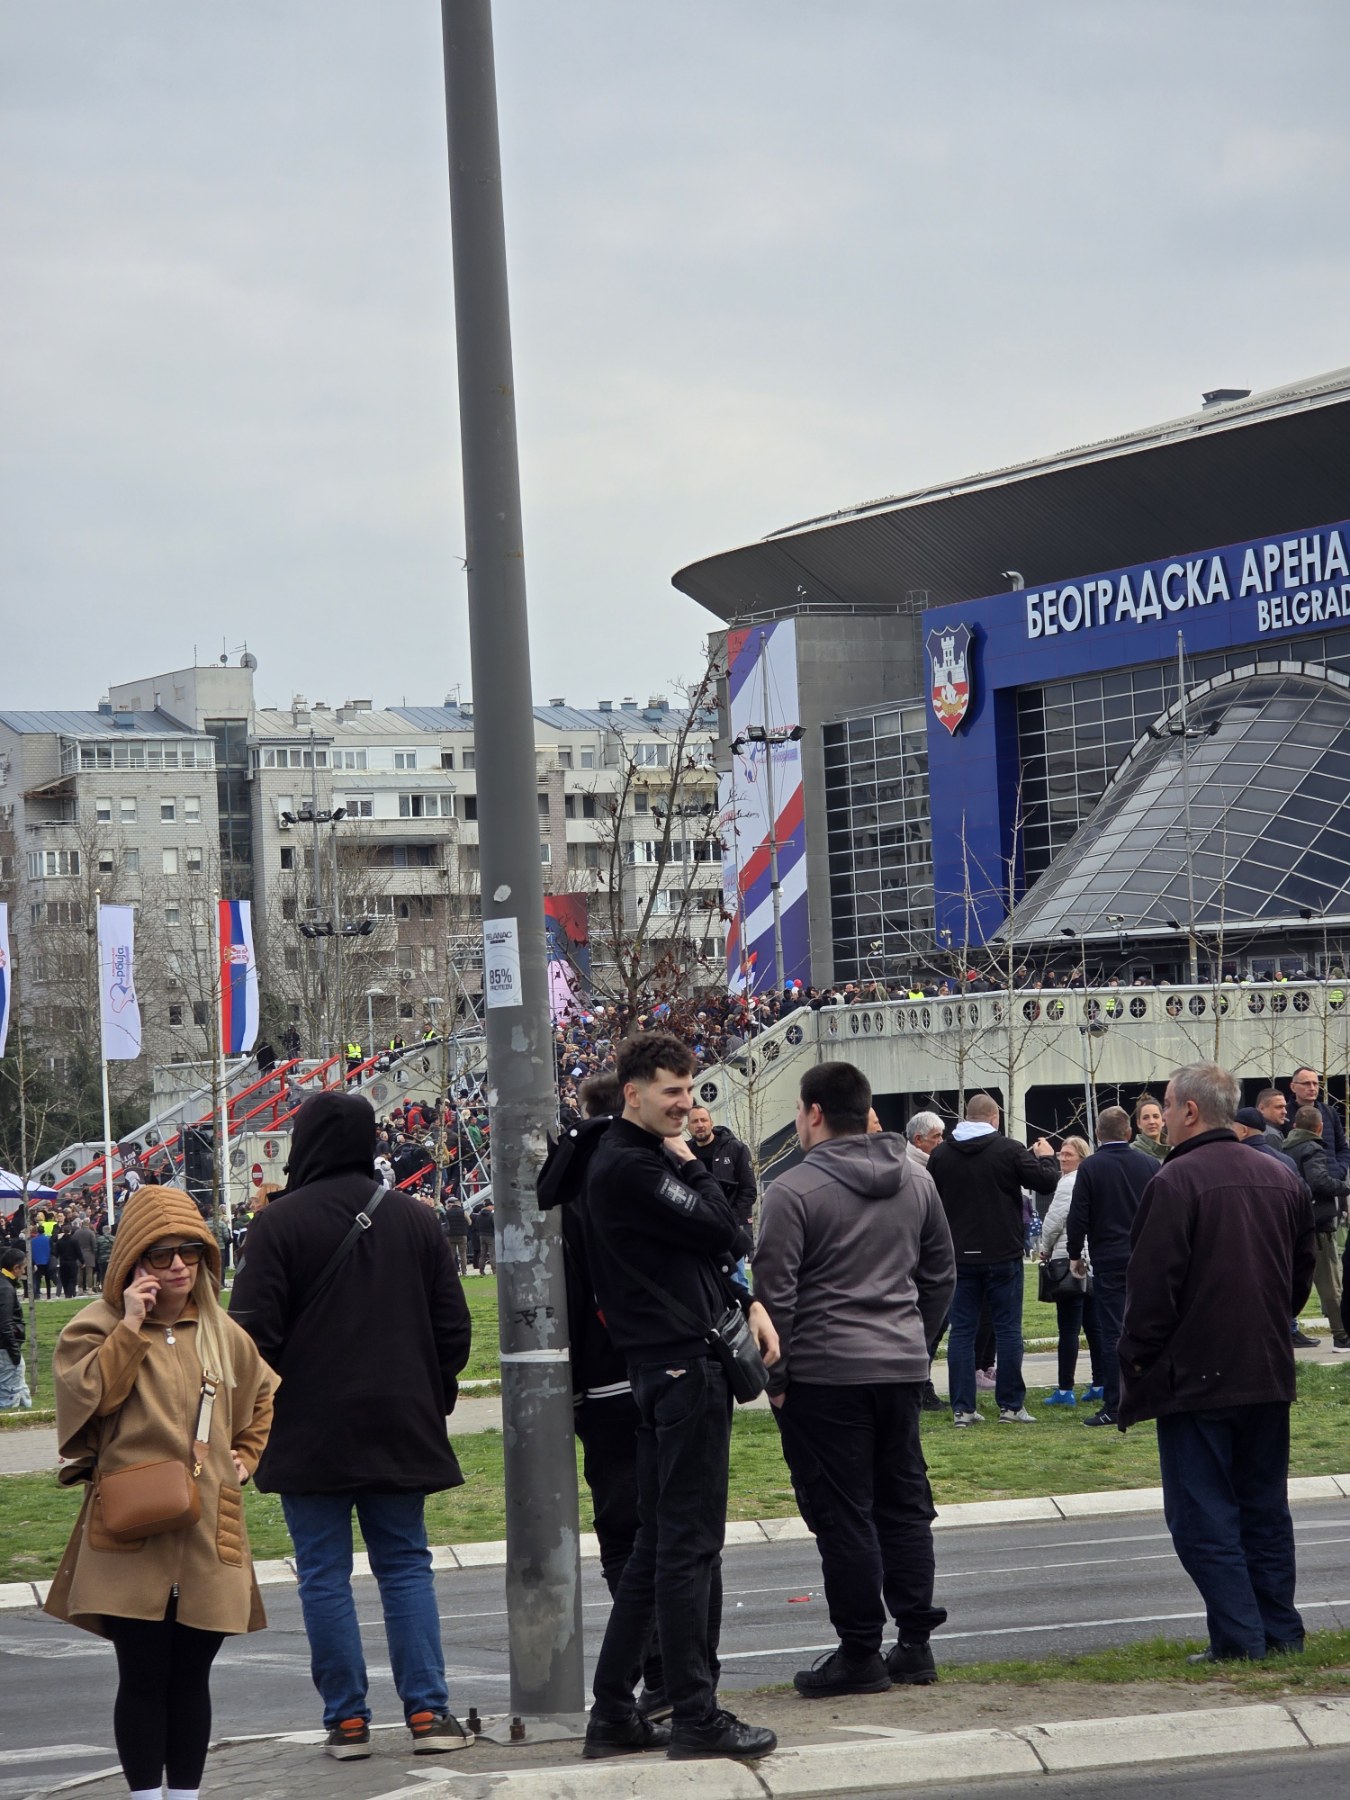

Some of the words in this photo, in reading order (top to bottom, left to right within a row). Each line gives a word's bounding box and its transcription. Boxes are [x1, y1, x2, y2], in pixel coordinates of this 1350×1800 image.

[1026, 555, 1231, 639] БЕОГРАДСКА
[1239, 530, 1350, 598] АРЕНА
[489, 968, 512, 984] 85%
